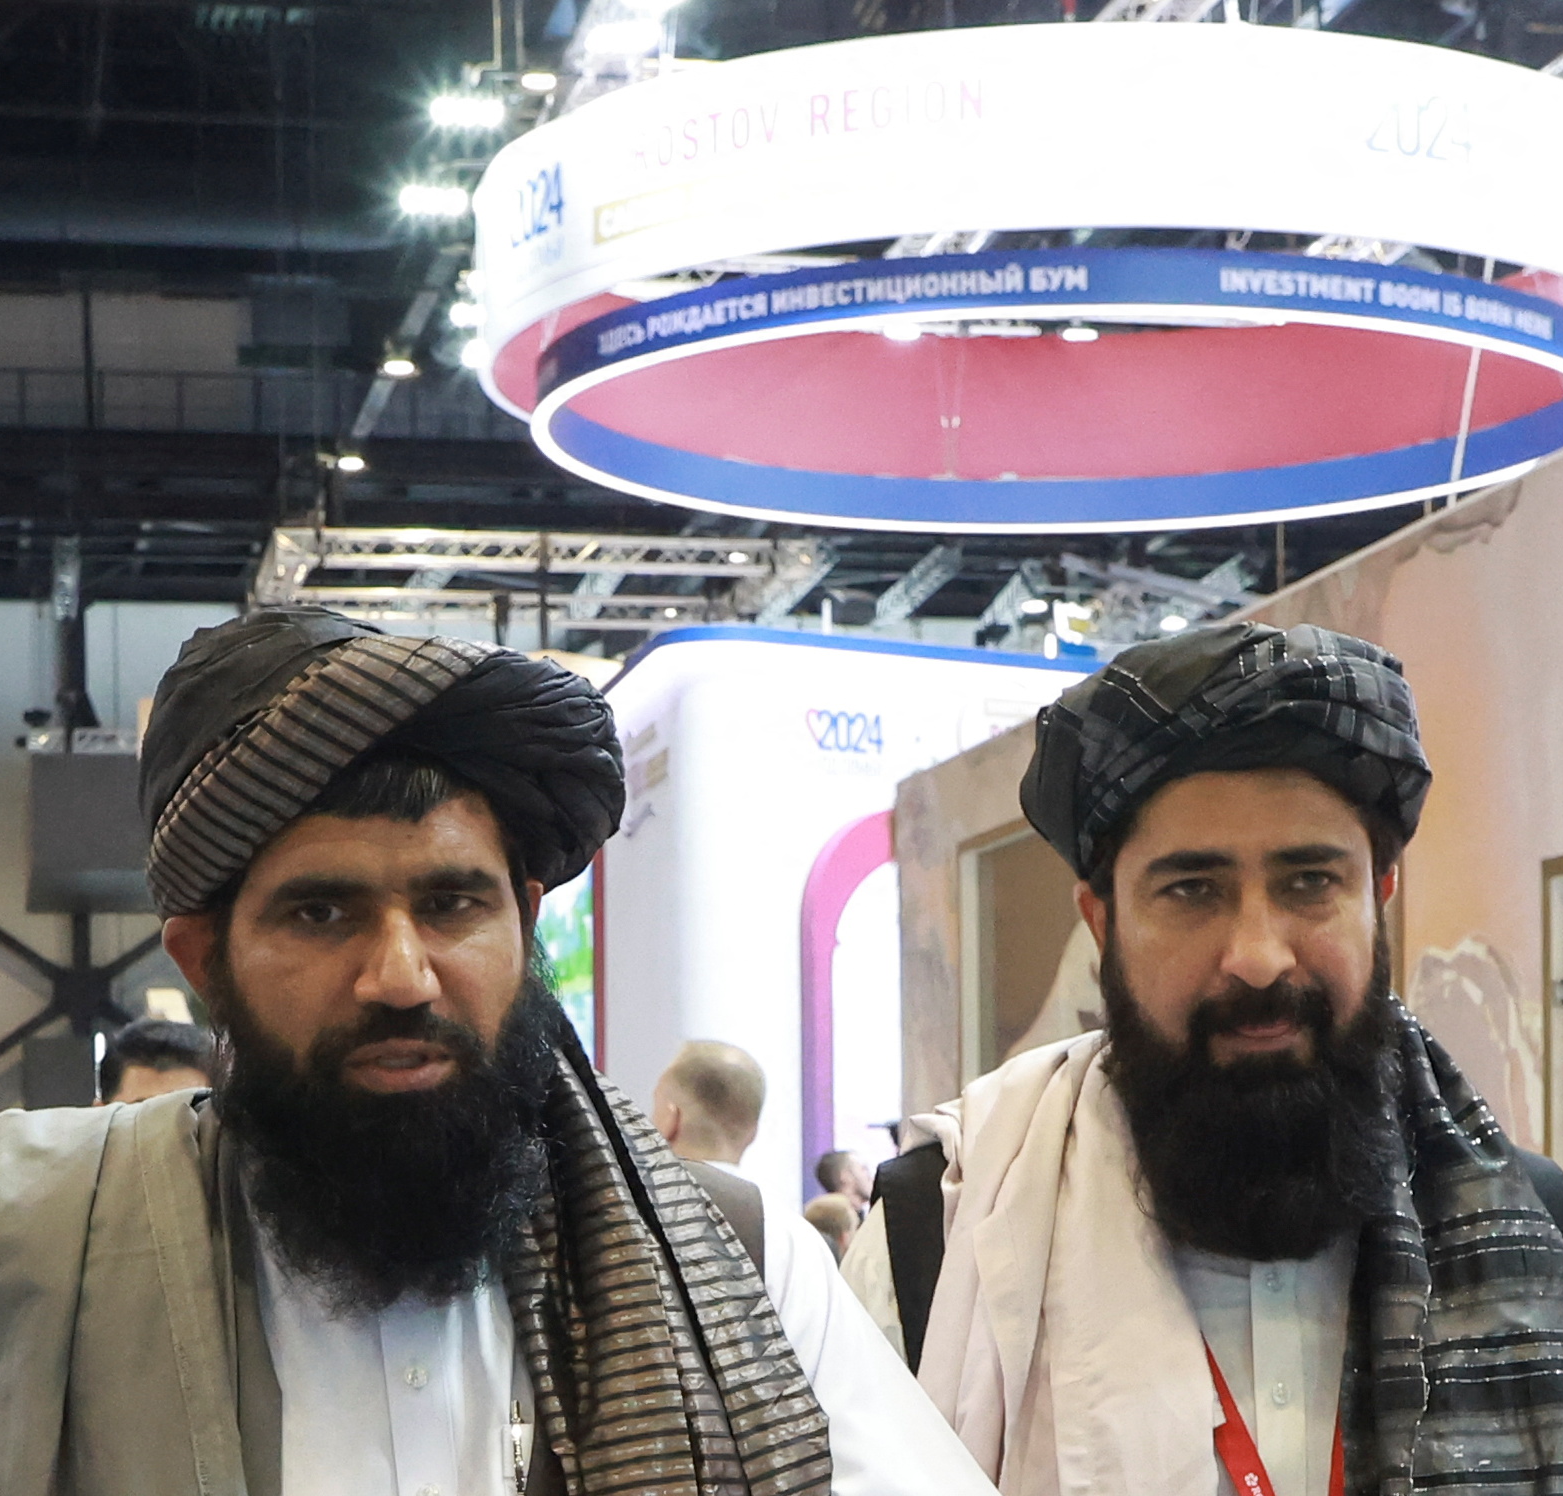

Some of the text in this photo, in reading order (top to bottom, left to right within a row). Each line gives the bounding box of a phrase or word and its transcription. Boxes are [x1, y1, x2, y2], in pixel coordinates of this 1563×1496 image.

[810, 79, 984, 137] REGION
[646, 290, 769, 341] РОЖДАЕТСЯ
[770, 262, 1024, 315] ИНВЕСТИЦИОННЫЙ
[1028, 264, 1088, 293] БУМ
[1219, 266, 1376, 304] INVESTMENT
[816, 709, 884, 755] 2024
